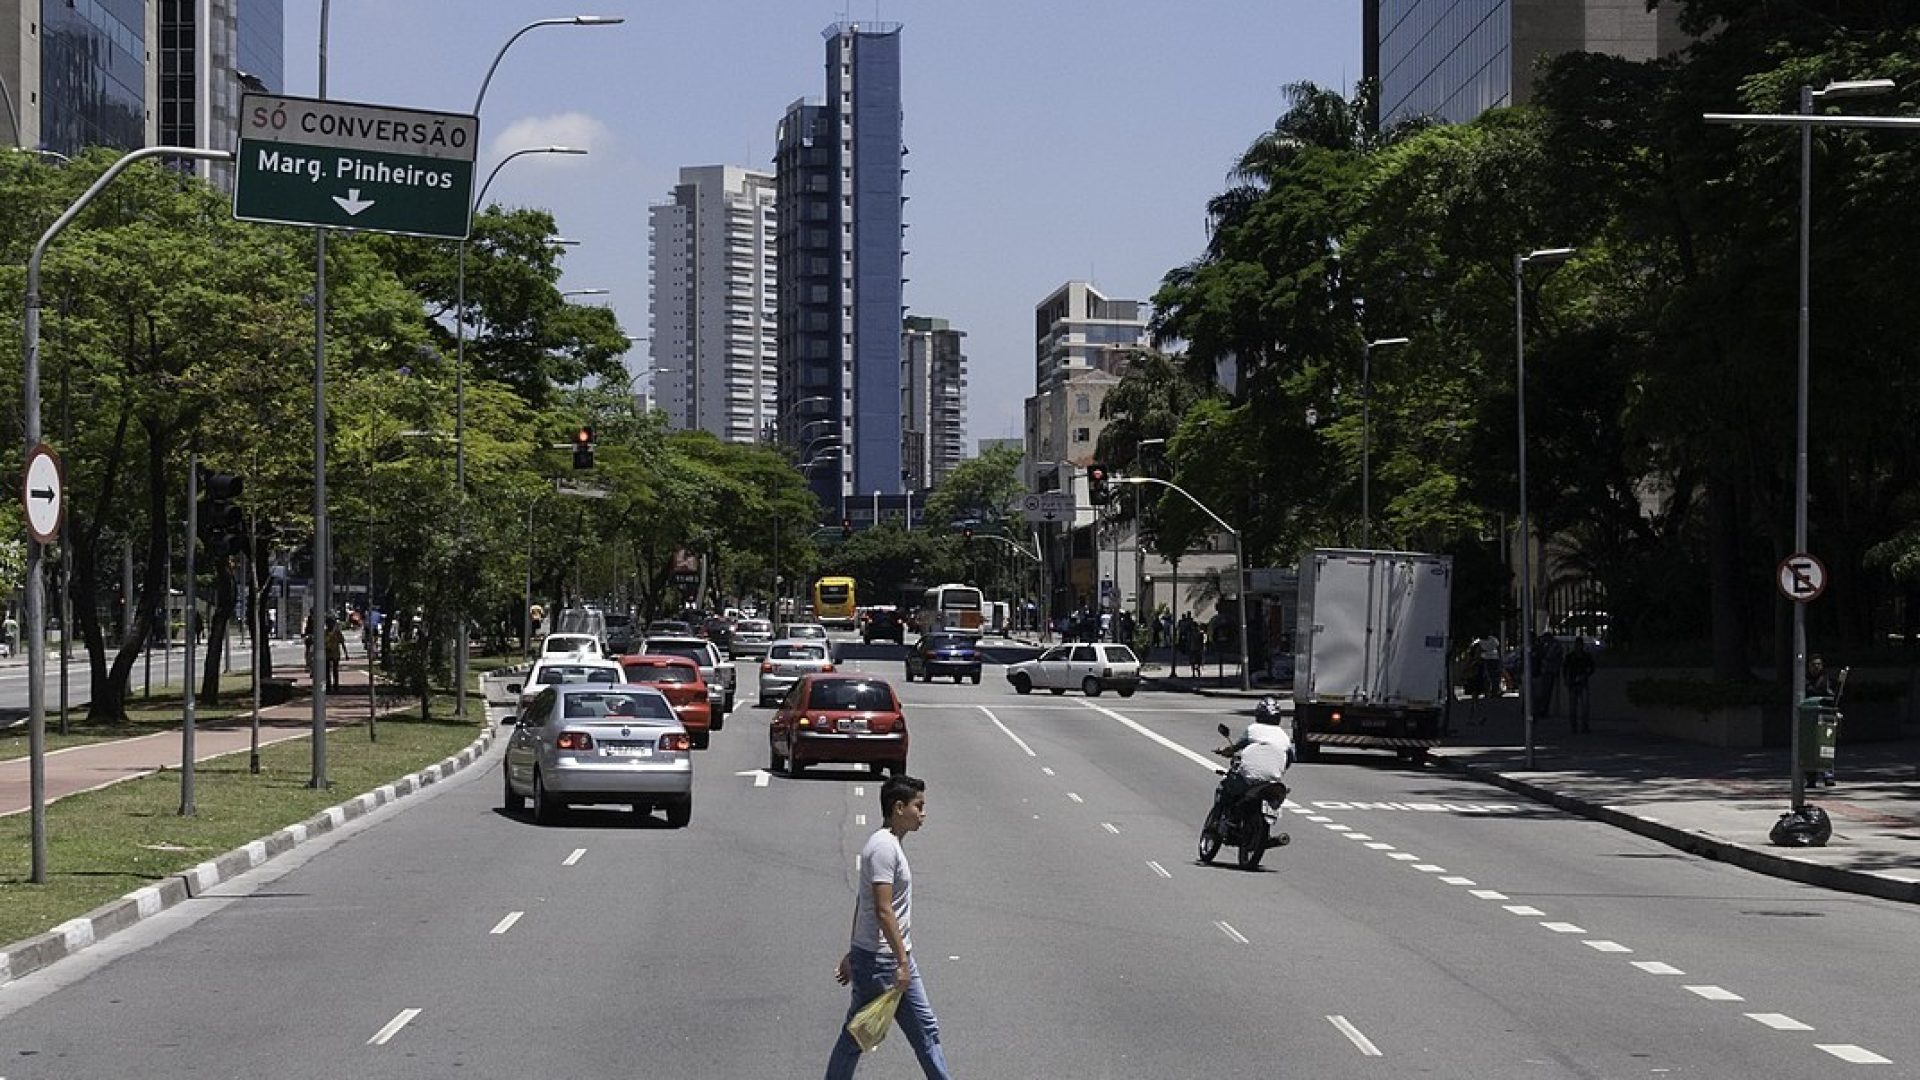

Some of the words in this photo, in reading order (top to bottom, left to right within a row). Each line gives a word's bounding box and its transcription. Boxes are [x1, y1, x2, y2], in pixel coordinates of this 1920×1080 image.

[252, 102, 288, 130] SÓ
[301, 111, 467, 148] CONVERSÃO
[257, 149, 327, 182] Marg.
[337, 157, 453, 189] Pinheiros
